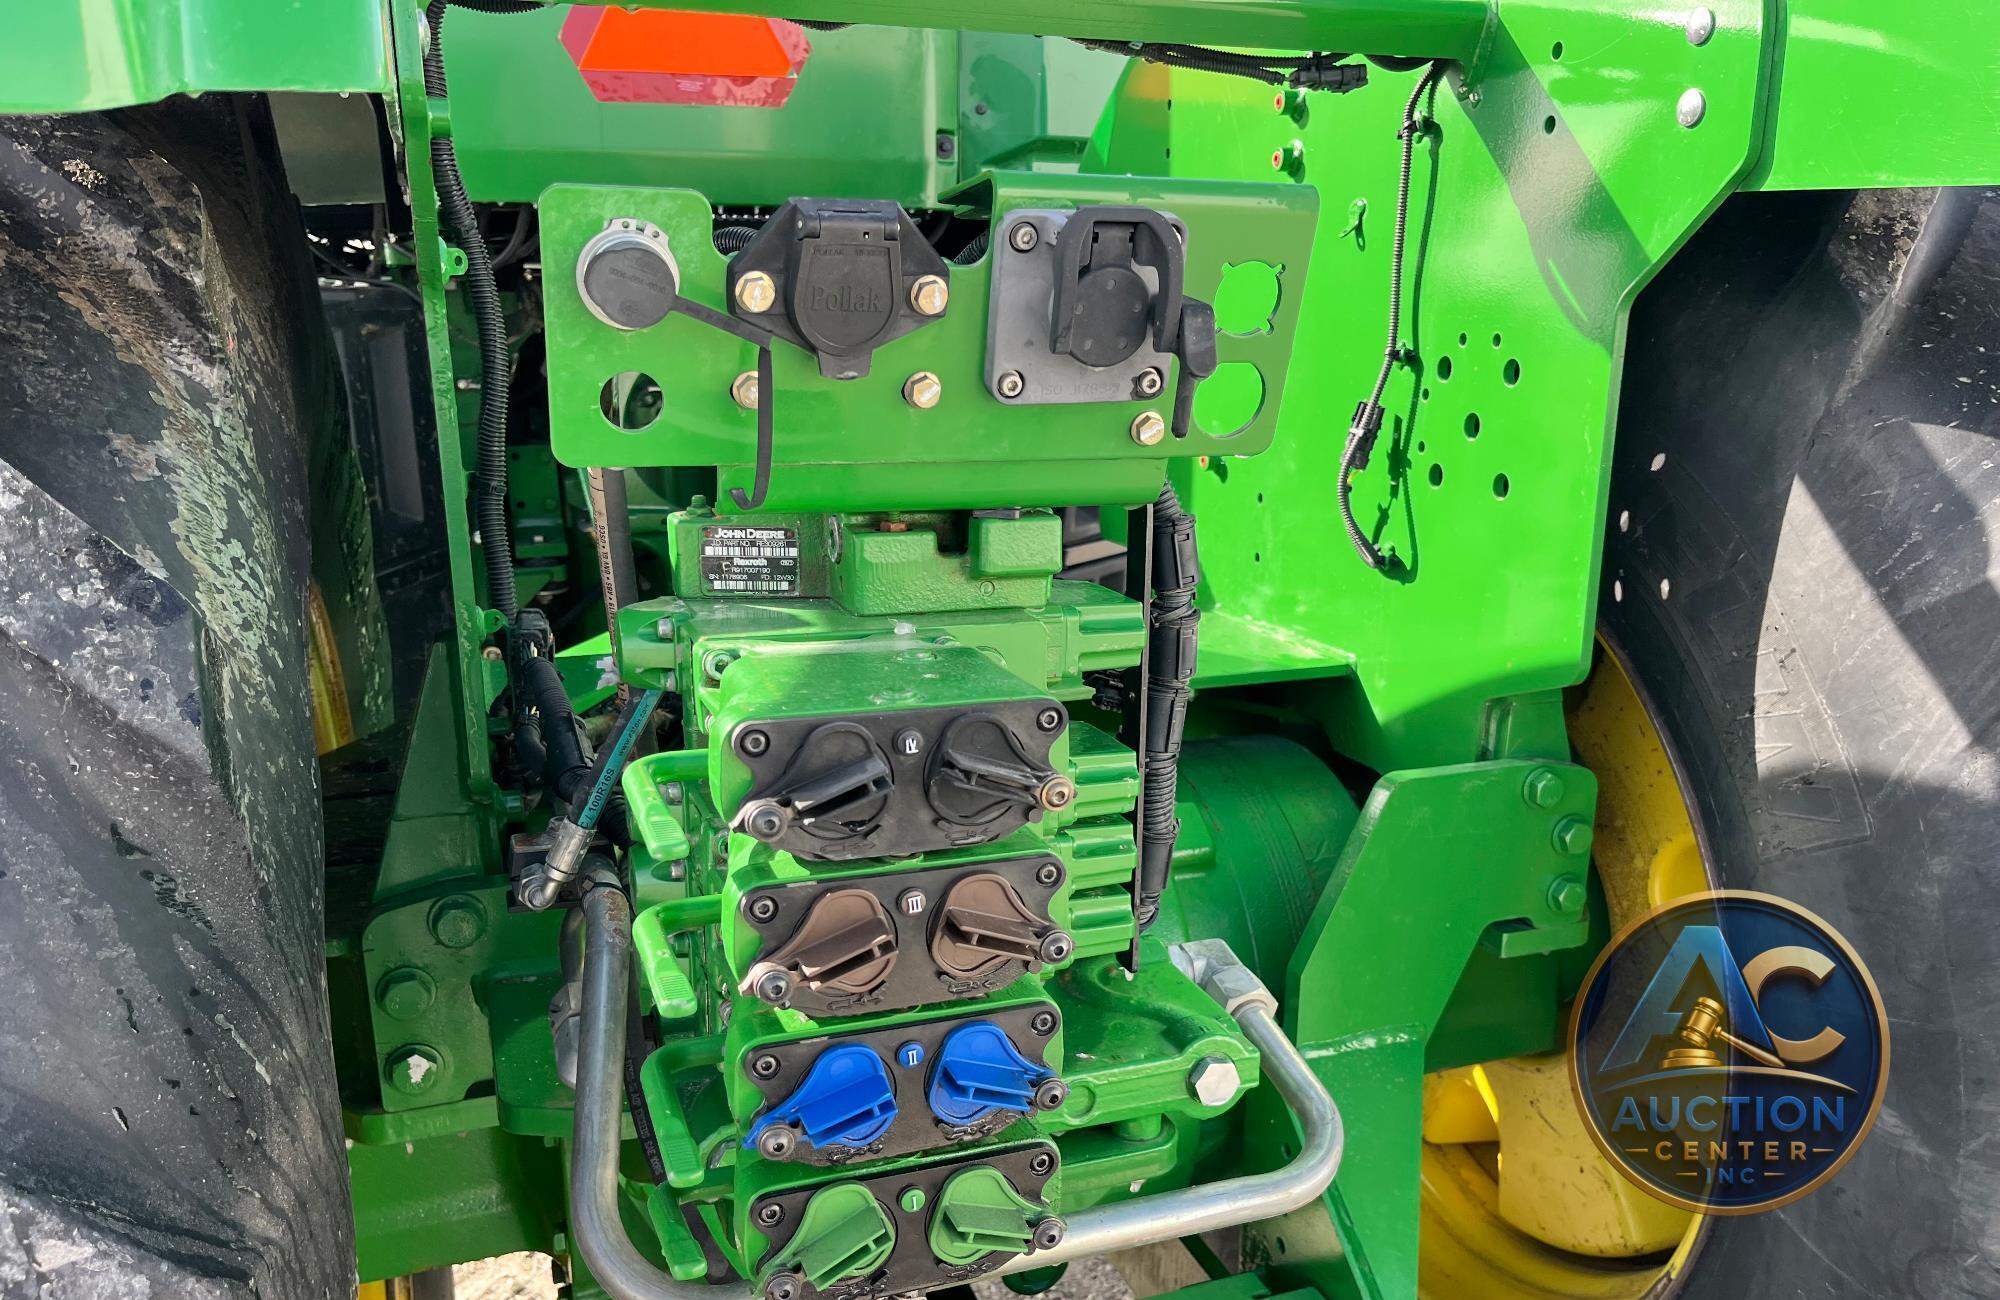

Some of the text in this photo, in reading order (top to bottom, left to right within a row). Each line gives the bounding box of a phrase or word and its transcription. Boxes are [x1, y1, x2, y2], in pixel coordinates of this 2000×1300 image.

[810, 286, 883, 313] Pollak
[1041, 383, 1063, 395] ISO
[599, 525, 607, 544] USCG
[715, 528, 785, 539] JOHN DEERE
[734, 557, 767, 566] Rexroth
[589, 768, 614, 812] 100R16S
